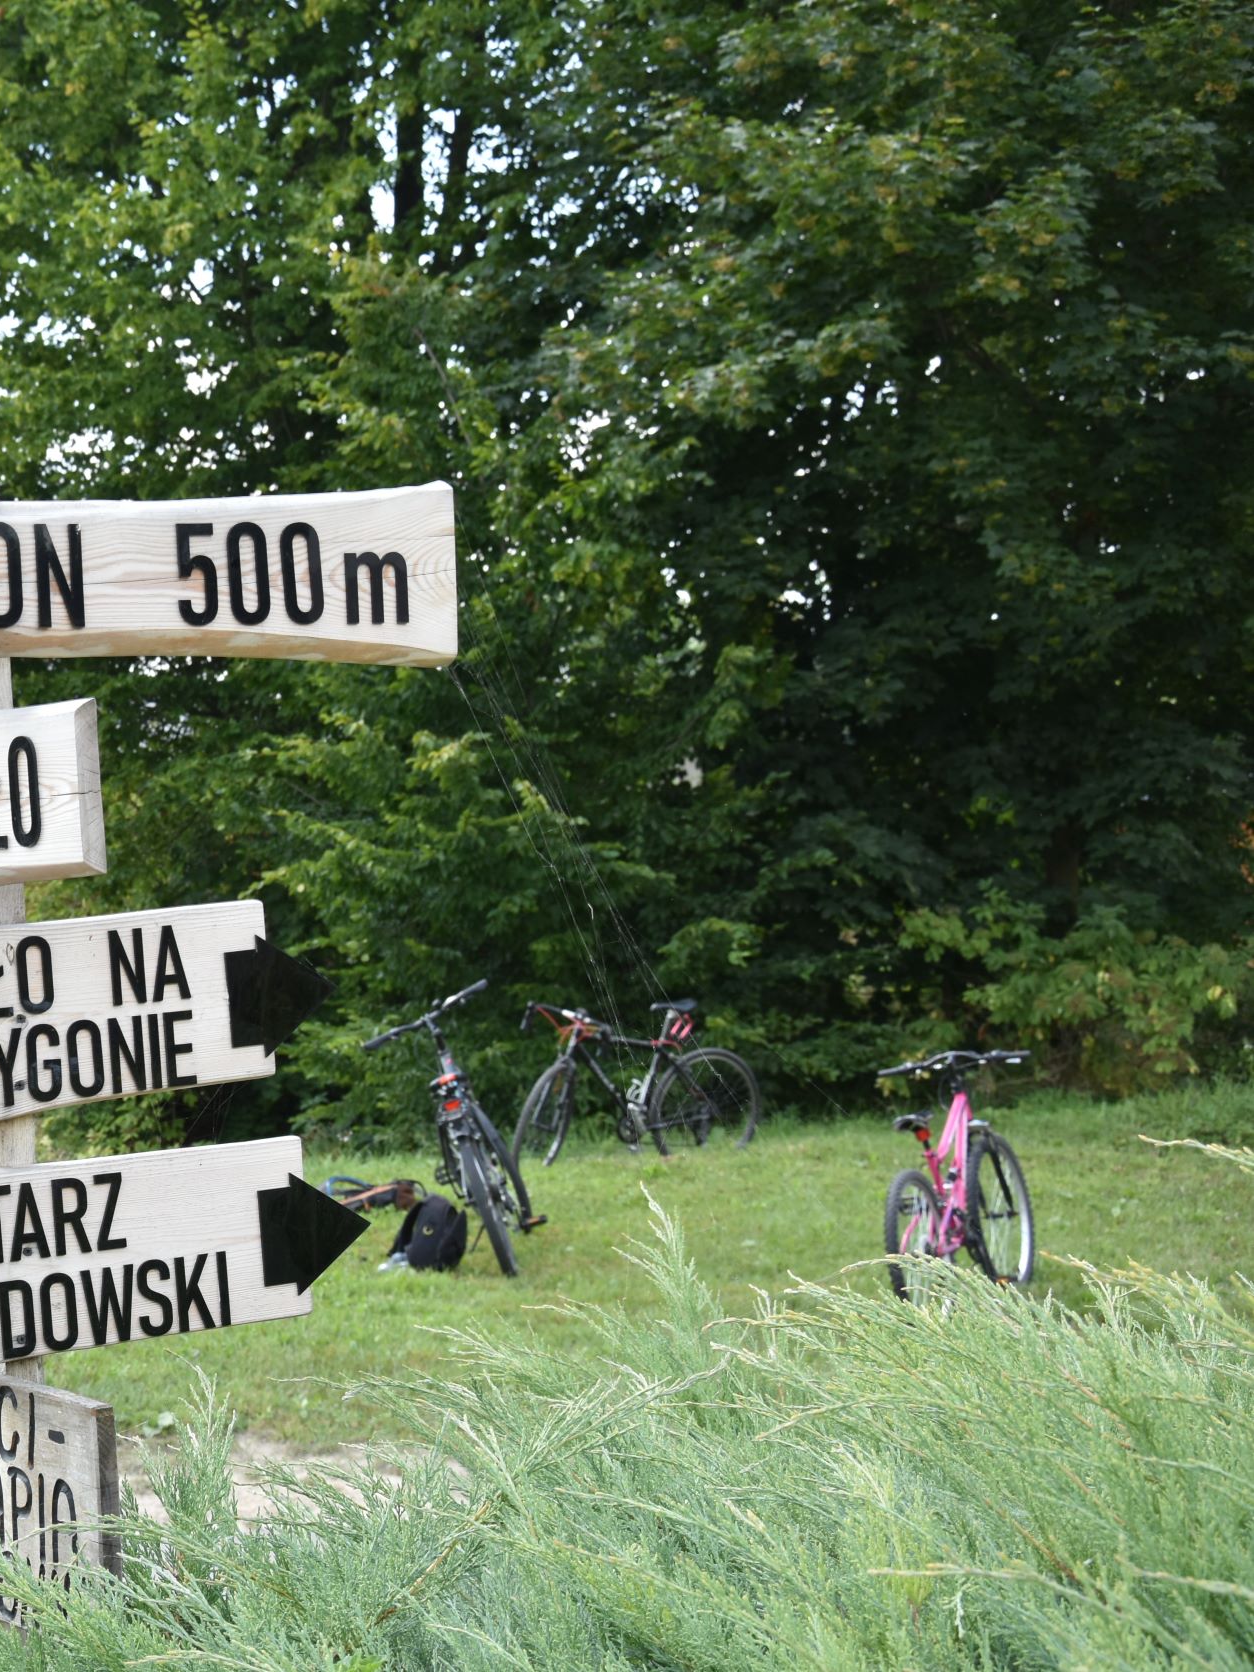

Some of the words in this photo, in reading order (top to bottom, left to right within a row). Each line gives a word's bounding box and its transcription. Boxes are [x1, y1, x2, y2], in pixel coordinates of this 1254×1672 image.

[176, 521, 325, 626] 500
[346, 549, 411, 625] m
[107, 924, 192, 1006] NA
